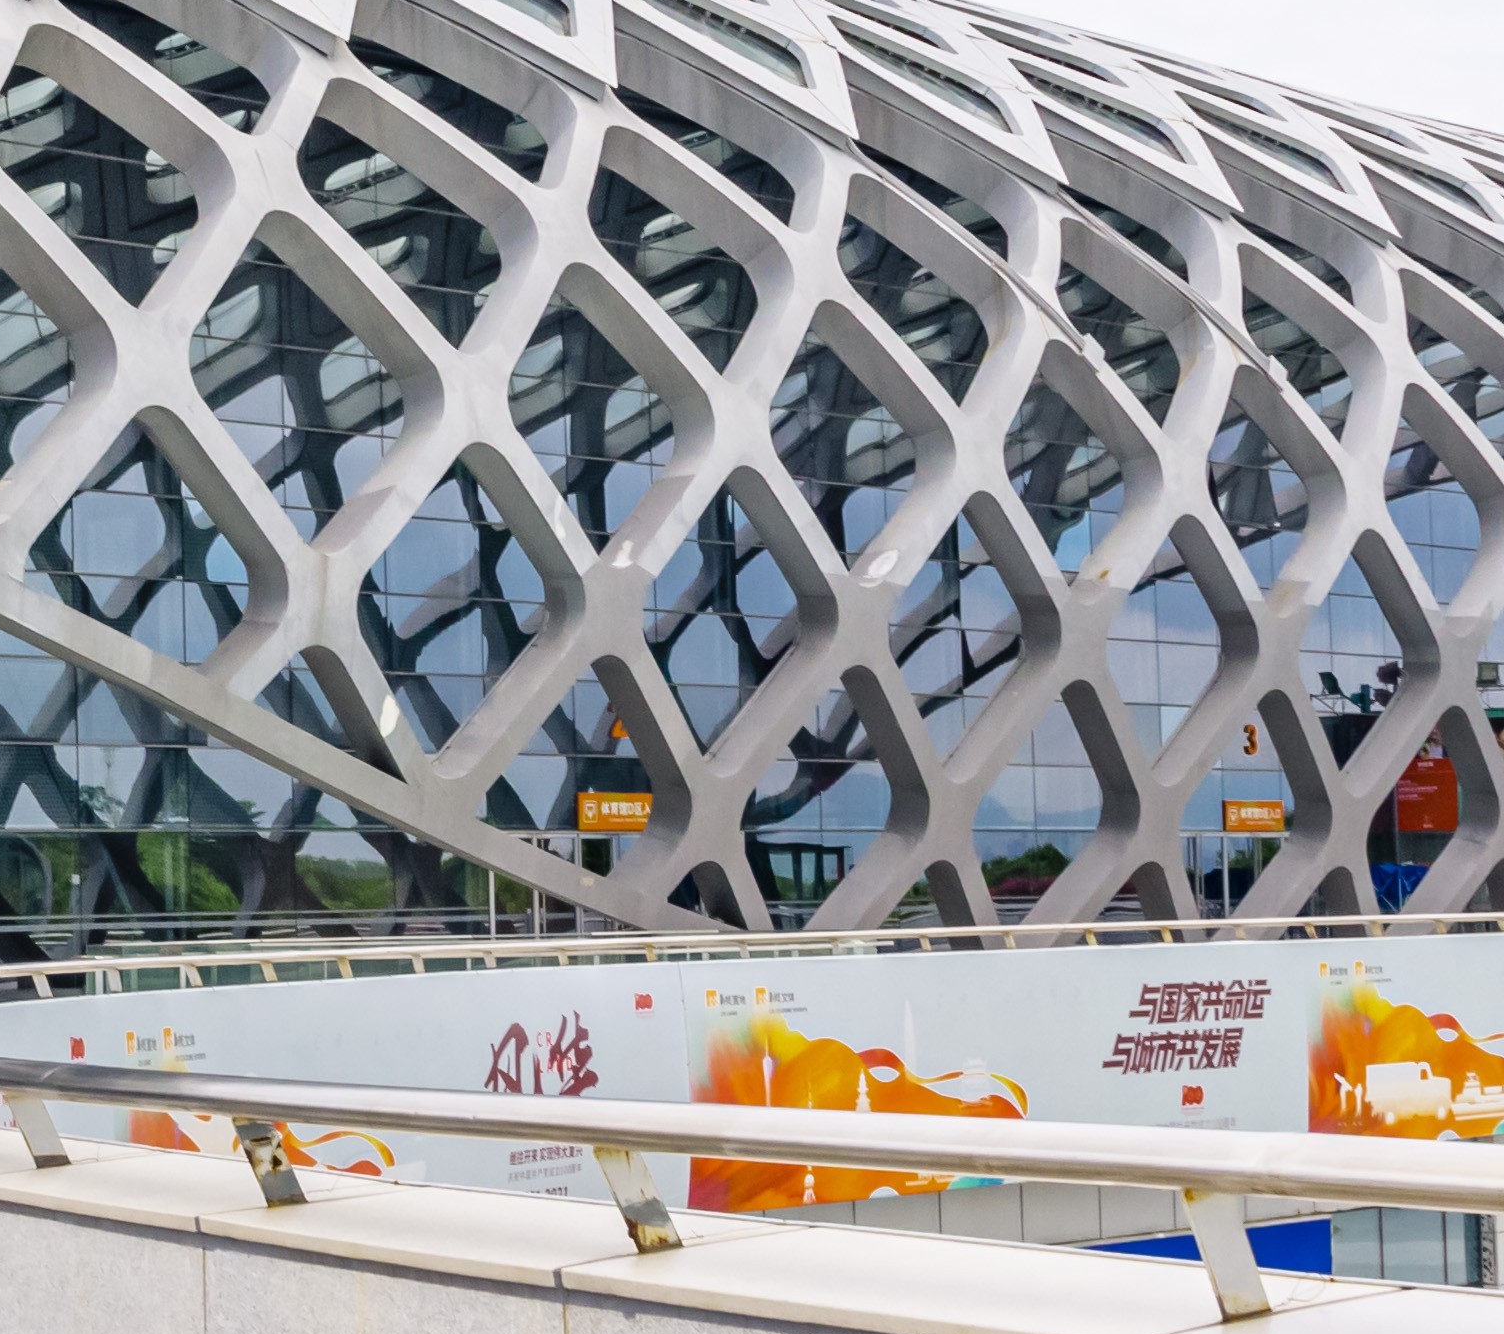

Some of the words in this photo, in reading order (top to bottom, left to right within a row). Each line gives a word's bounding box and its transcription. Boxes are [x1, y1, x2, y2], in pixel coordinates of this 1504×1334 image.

[1243, 724, 1259, 756] 3
[1129, 979, 1272, 1025] 与国家共命运
[1101, 1027, 1245, 1075] 与城市共发展
